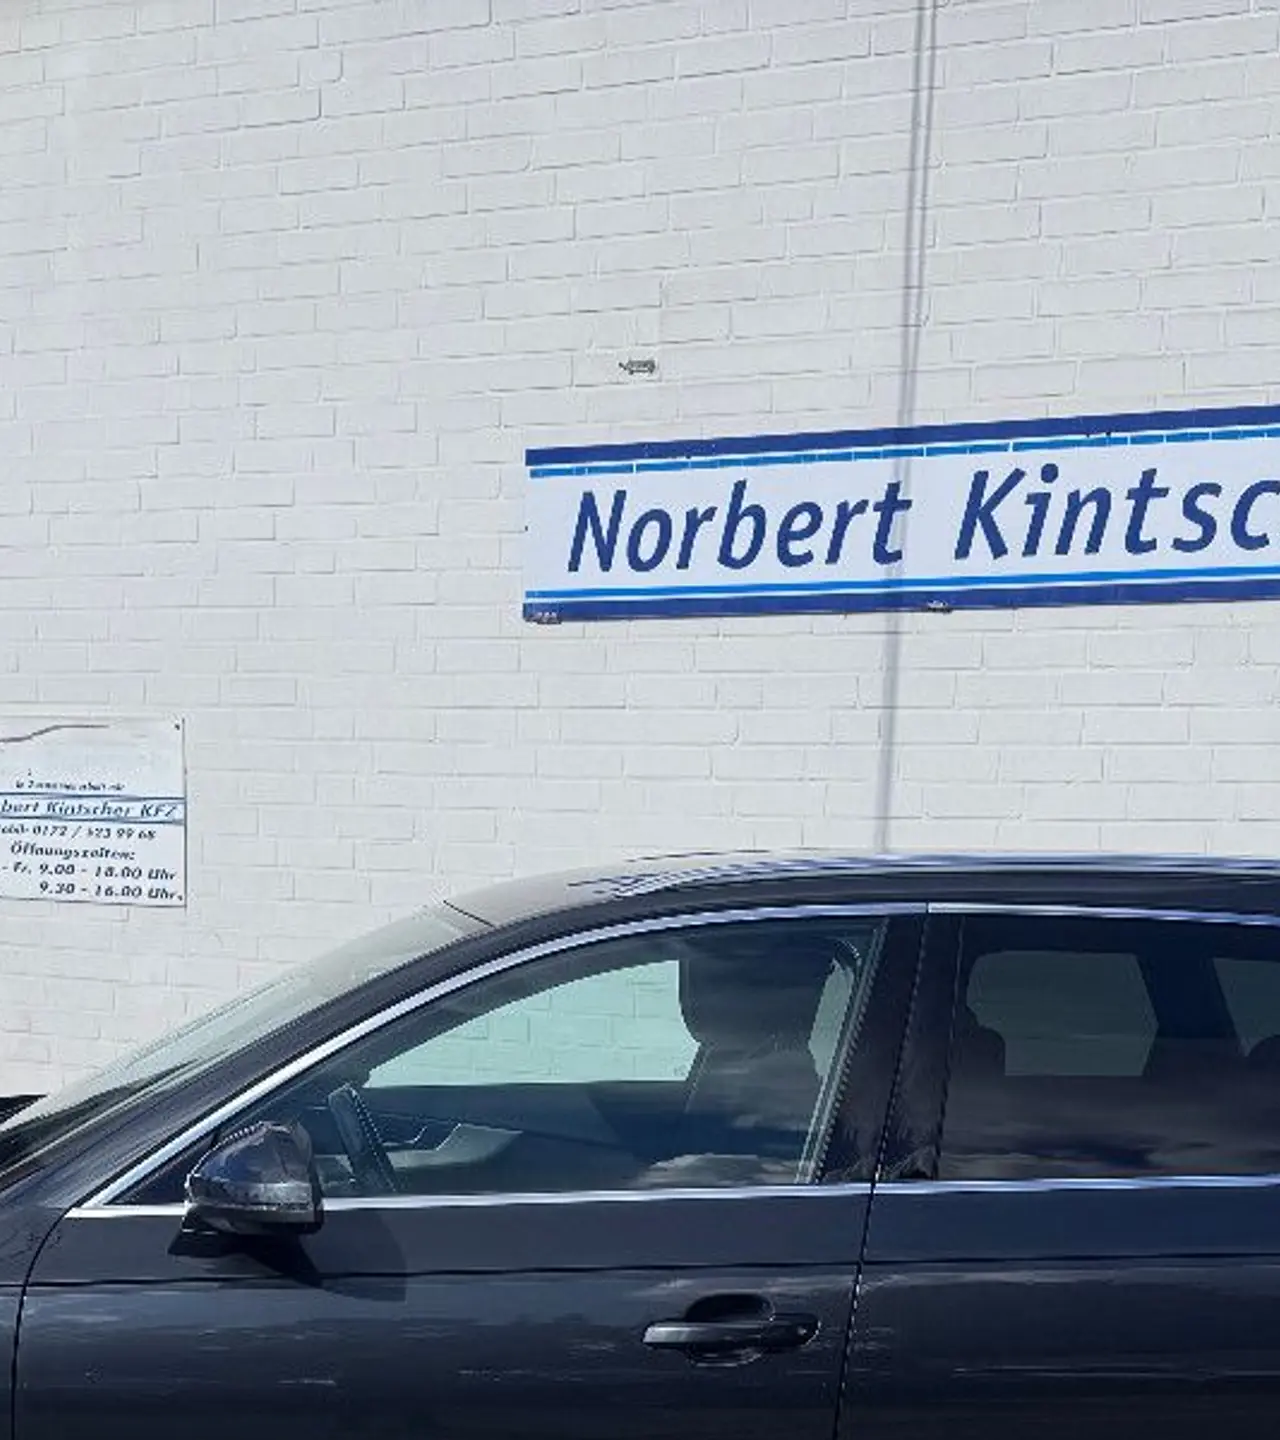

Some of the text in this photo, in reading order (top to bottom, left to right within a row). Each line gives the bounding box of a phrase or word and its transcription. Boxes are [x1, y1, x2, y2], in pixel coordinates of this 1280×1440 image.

[567, 478, 913, 573] Norbert
[46, 801, 134, 818] Kintscher
[140, 803, 177, 818] KFZ
[10, 839, 136, 861] Öffnungszeiten:
[39, 863, 76, 875] 9.00
[94, 865, 143, 880] 18.00
[39, 881, 76, 894] 9.30
[94, 885, 143, 898] 16.00
